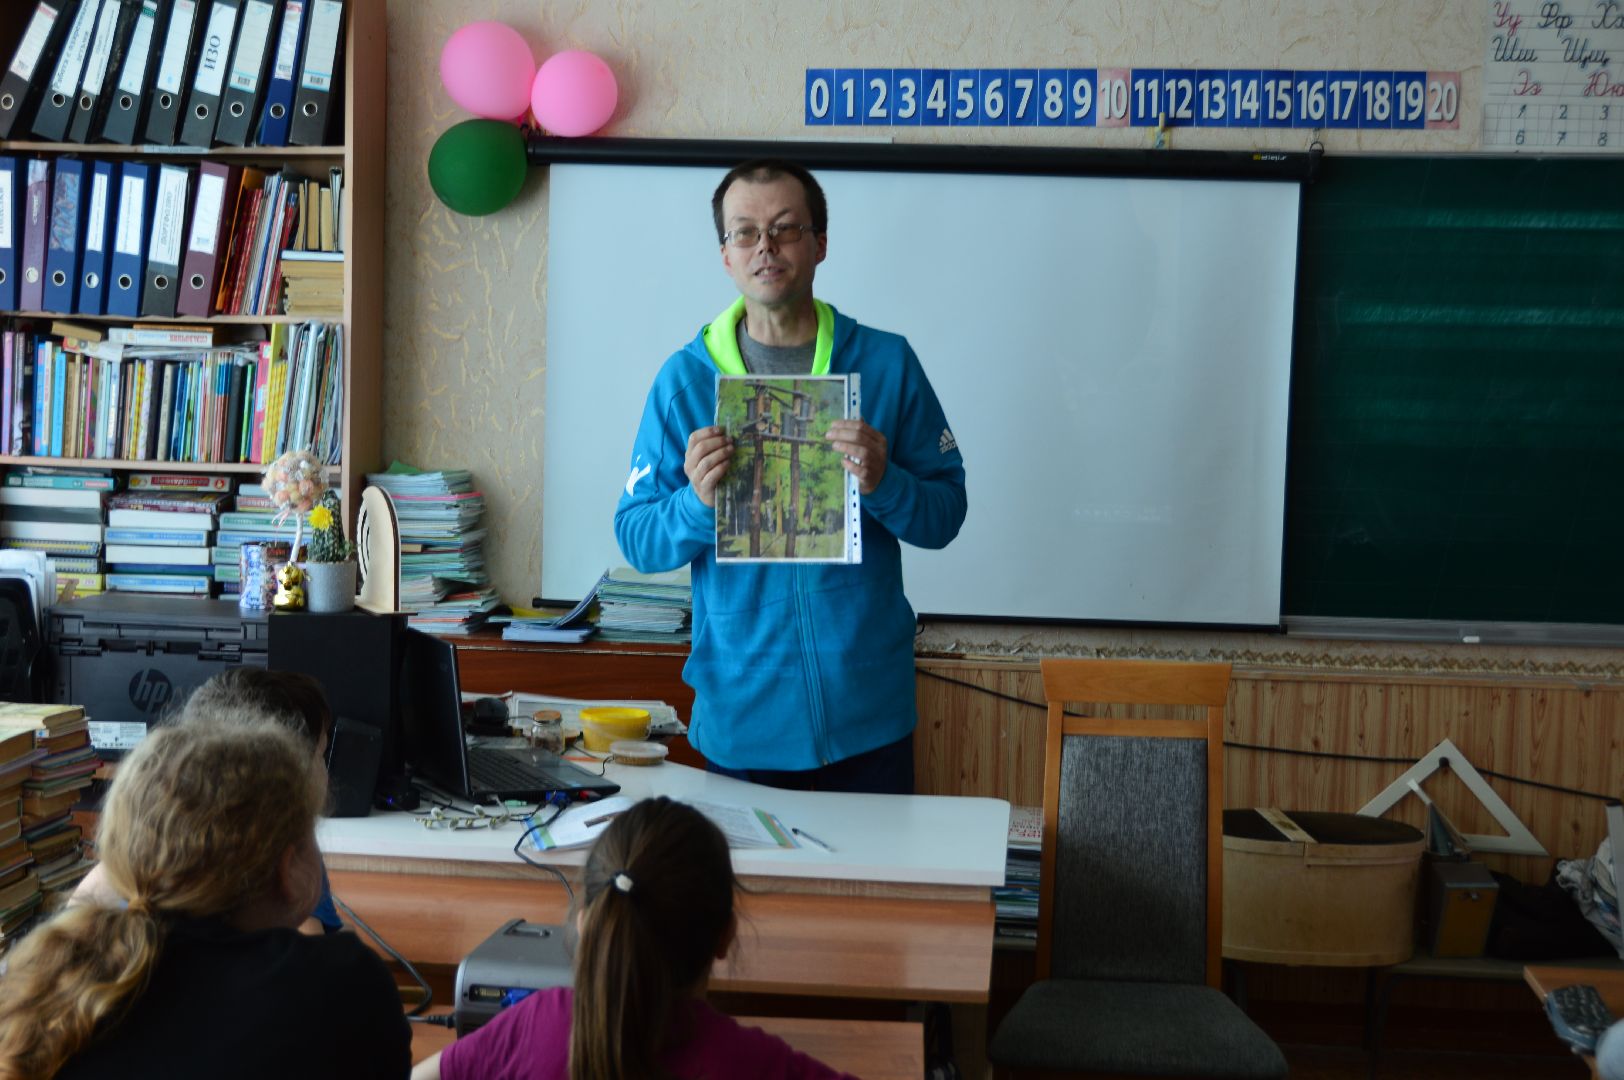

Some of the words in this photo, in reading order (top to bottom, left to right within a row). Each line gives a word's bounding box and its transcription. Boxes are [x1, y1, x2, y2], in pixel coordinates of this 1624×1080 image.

[204, 35, 221, 70] ИЗО
[810, 78, 830, 118] 0
[841, 78, 855, 118] 1
[868, 78, 888, 118] 2
[897, 78, 916, 119] 3
[926, 78, 947, 118] 4
[955, 78, 974, 119] 5
[984, 78, 1004, 119] 6
[1014, 78, 1034, 119] 7
[1043, 78, 1064, 119] 8
[1072, 78, 1092, 119] 9
[1101, 78, 1129, 120] 10
[1134, 78, 1159, 119] 11
[1165, 78, 1193, 119] 12
[1198, 79, 1226, 119] 13
[1230, 79, 1260, 120] 14
[1264, 79, 1292, 120] 15
[1297, 79, 1325, 121] 16
[1329, 80, 1358, 121] 17
[1362, 80, 1391, 121] 18
[1395, 80, 1424, 121] 19
[1428, 80, 1458, 121] 20
[1516, 104, 1527, 119] 1
[1559, 104, 1568, 120] 2
[1599, 104, 1610, 121] 3
[1515, 129, 1526, 146] 6
[1556, 131, 1567, 147] 7
[1597, 131, 1608, 147] 8
[132, 669, 169, 712] hp
